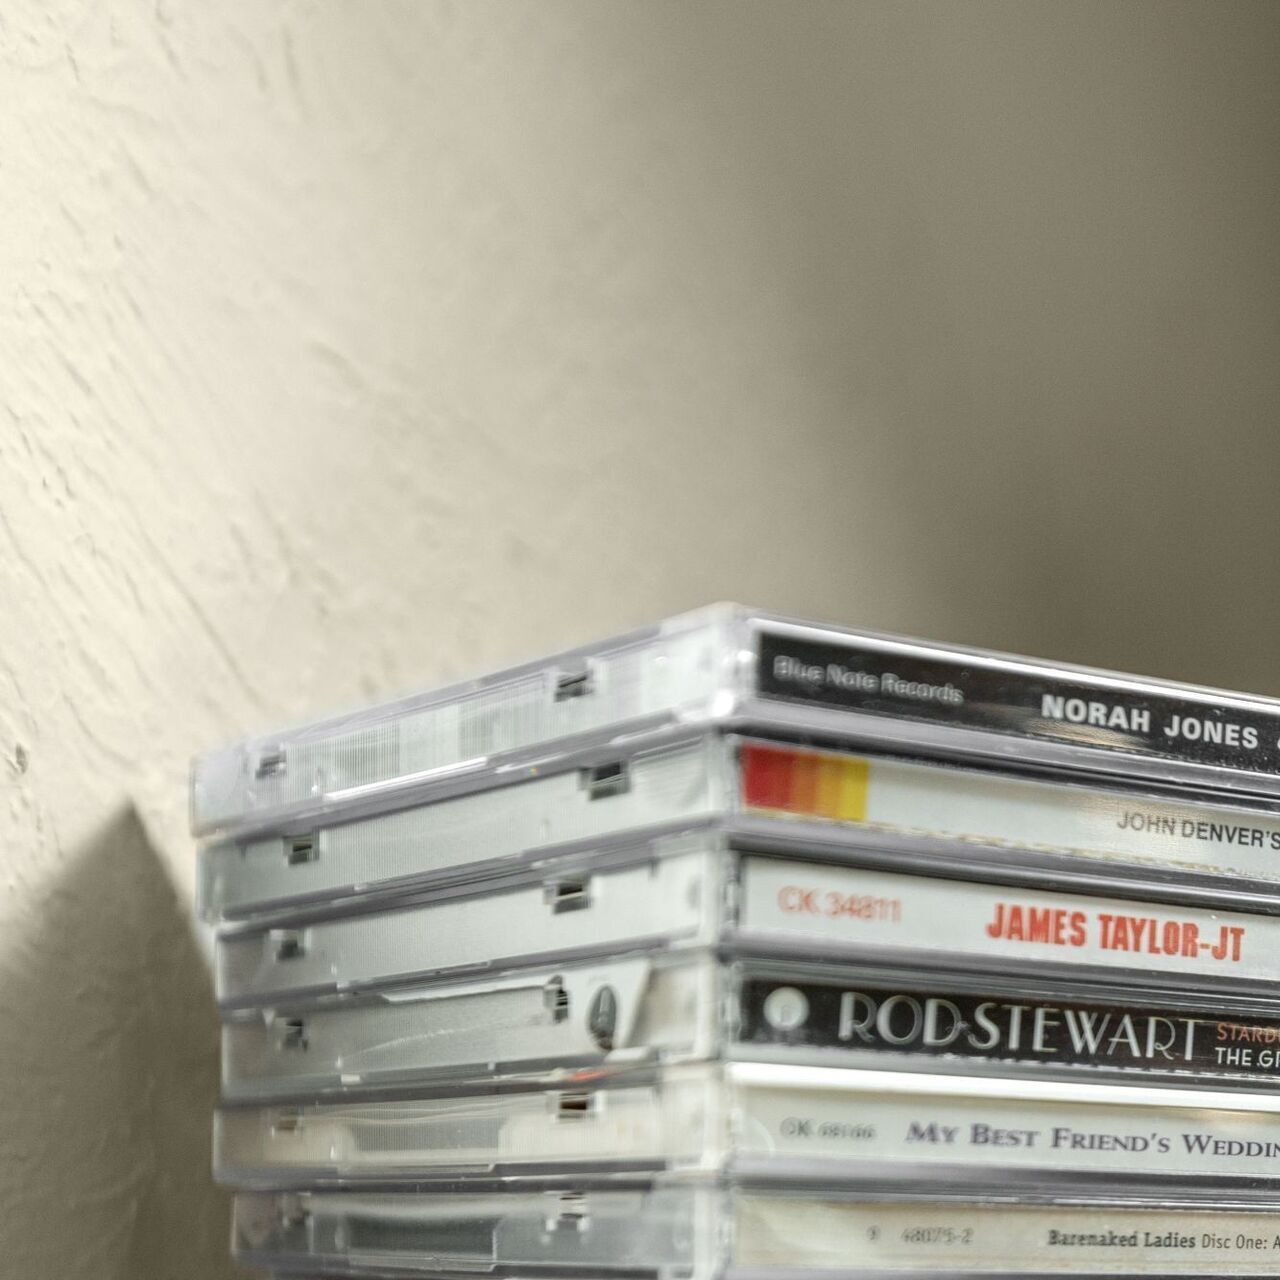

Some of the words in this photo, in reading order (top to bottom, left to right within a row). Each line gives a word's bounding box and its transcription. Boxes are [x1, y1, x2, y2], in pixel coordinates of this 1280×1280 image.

[774, 656, 822, 686] Blue
[827, 667, 878, 694] Note
[880, 673, 964, 705] Records
[1041, 694, 1150, 733] NORAH
[1164, 714, 1258, 750] JONES
[1117, 812, 1176, 836] JOHN
[777, 885, 820, 915] CK
[986, 903, 1086, 947] JAMES
[1098, 913, 1245, 962] TAYLOR-JT
[838, 991, 965, 1047] ROD
[967, 1002, 1204, 1061] STEWART
[1215, 1047, 1252, 1067] THE
[905, 1120, 956, 1145] MY
[970, 1123, 1041, 1149] BEST
[1050, 1128, 1170, 1155] FRIEND'S
[1048, 1230, 1138, 1248] Barenaked
[1143, 1231, 1197, 1249] Ladies
[1202, 1234, 1231, 1251] Disc
[1236, 1235, 1268, 1251] One:
